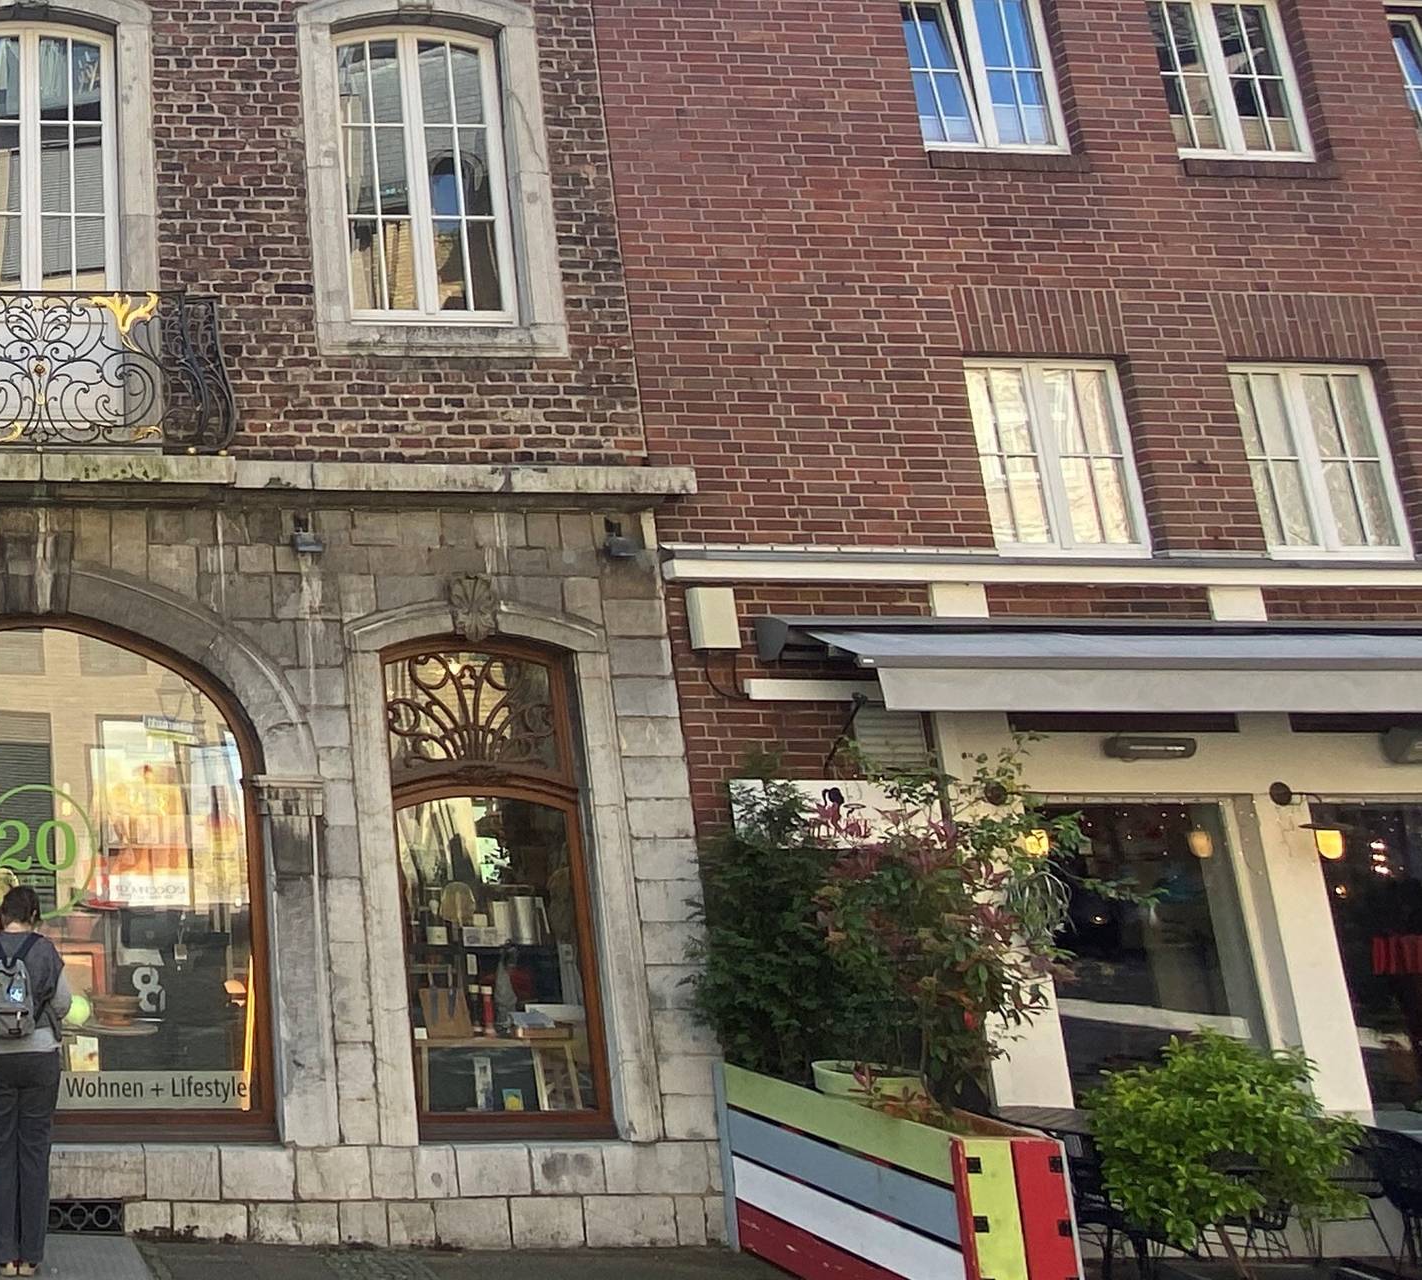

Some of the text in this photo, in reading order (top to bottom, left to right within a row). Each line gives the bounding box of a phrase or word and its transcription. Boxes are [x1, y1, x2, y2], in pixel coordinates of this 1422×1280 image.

[65, 1077, 144, 1098] Wohnen
[151, 1083, 165, 1097] +
[171, 1075, 248, 1103] Lifestyle
